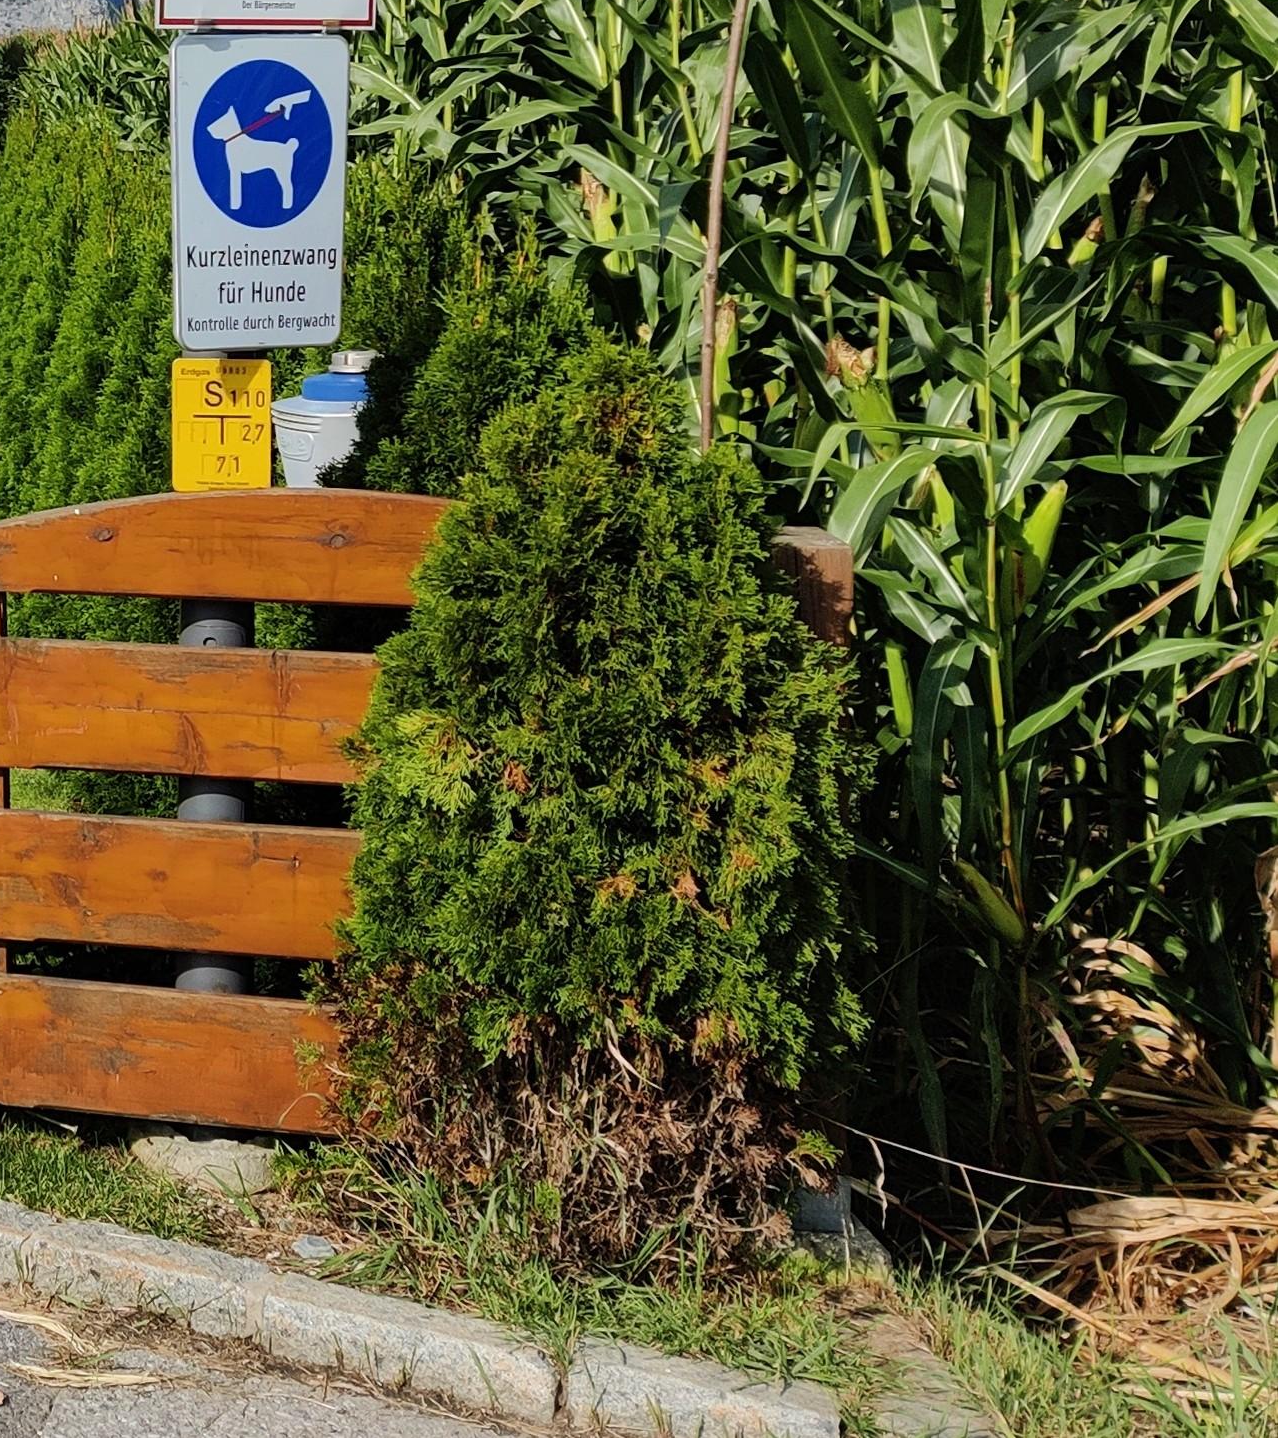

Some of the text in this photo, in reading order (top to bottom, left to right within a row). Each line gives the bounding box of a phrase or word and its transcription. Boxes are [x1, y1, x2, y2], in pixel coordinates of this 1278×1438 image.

[186, 244, 338, 270] Kurzleinenzwang
[218, 280, 307, 304] für Hunde
[187, 313, 337, 332] Kontrolle durch Bergwacht
[180, 367, 211, 376] Erdgas
